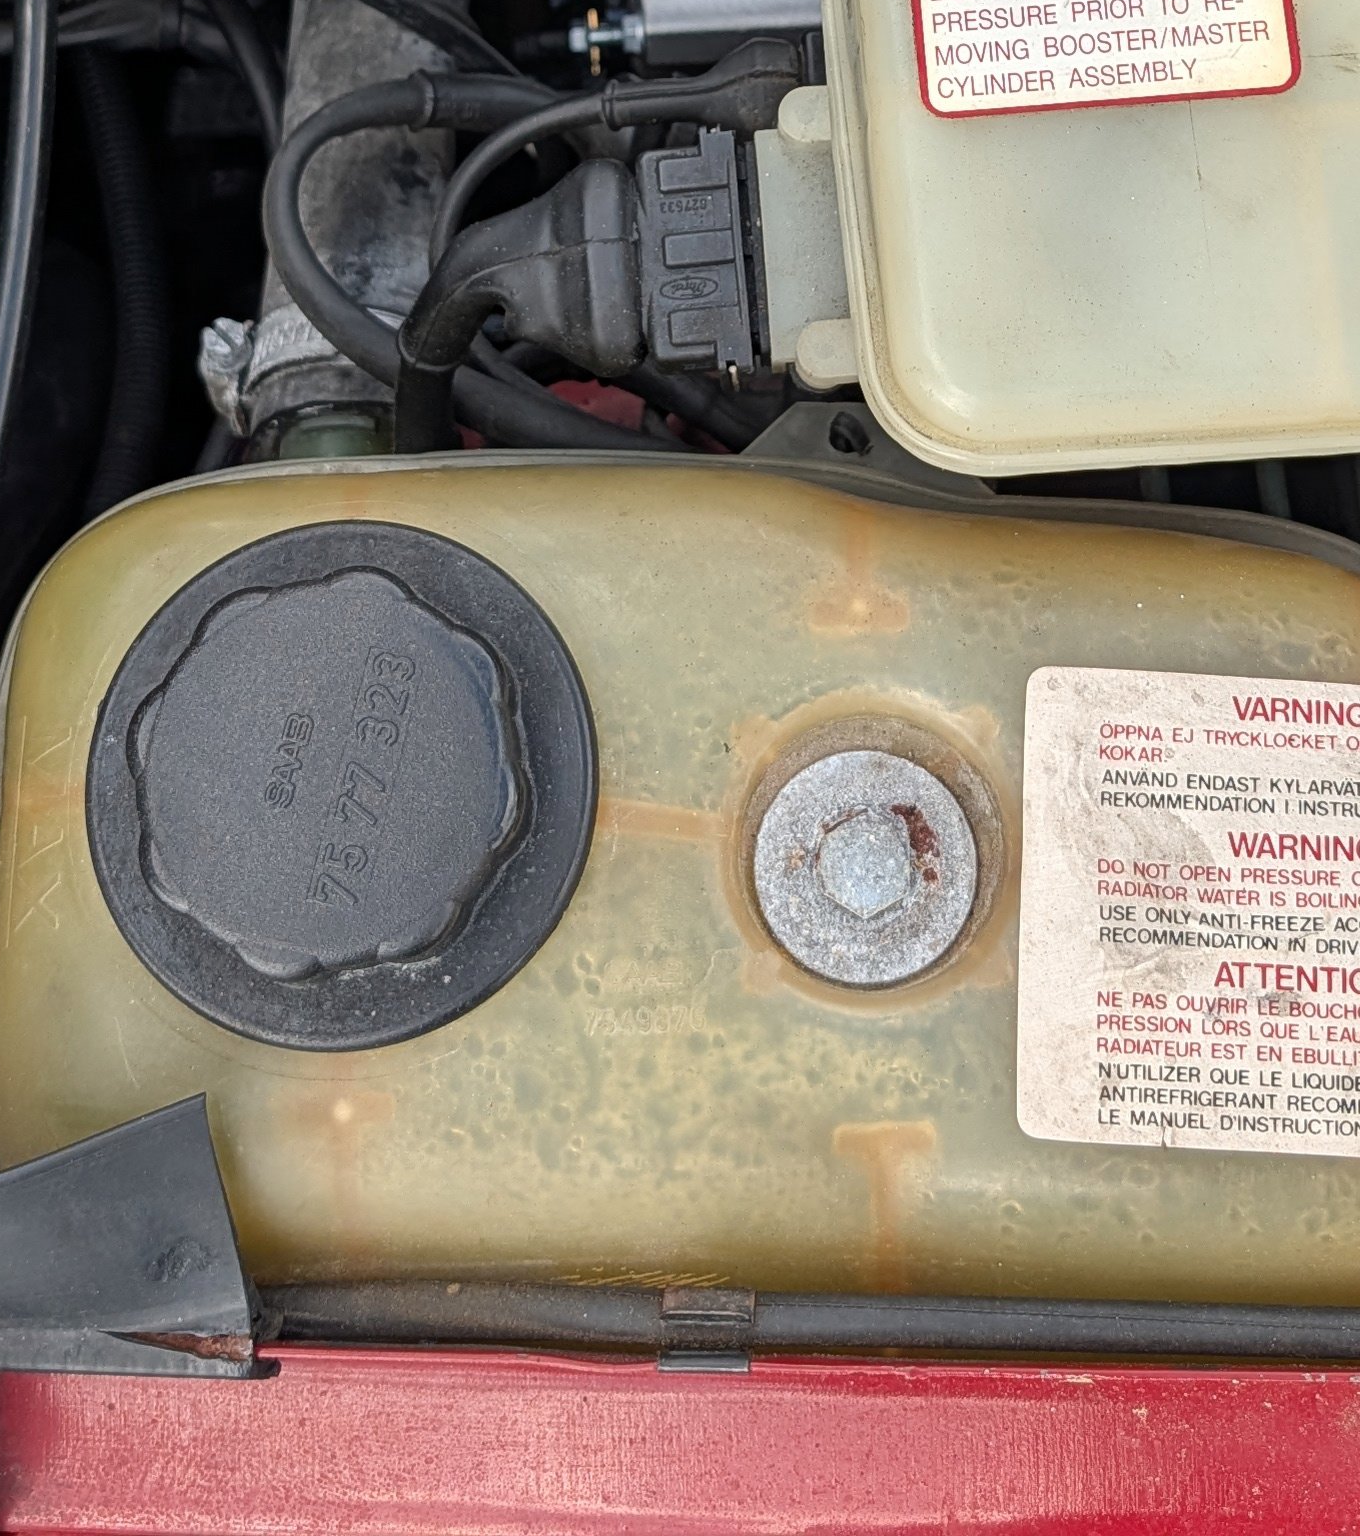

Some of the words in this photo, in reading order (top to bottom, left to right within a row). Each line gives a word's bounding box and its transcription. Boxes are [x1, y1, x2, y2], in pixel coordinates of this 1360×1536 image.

[933, 4, 1057, 33] PRESSURE
[935, 38, 1030, 65] MOVING
[937, 69, 1054, 99] CYLINDER
[1069, 58, 1197, 88] ASSEMBLY
[356, 650, 417, 747] 323
[1099, 723, 1164, 742] ÖPPNA
[1171, 727, 1195, 744] EJ
[1203, 728, 1339, 751] TRYCKLOCKET
[265, 712, 316, 811] SAAB
[334, 761, 387, 825] 77
[1101, 769, 1179, 790] ANVÄND
[1187, 774, 1261, 793] ENDAST
[1100, 792, 1278, 815] REKOMMENDATION
[1285, 798, 1291, 814] I
[307, 843, 369, 907] 75
[1098, 859, 1126, 876] DO
[1133, 861, 1172, 879] NOT
[1179, 863, 1231, 882] OPEN
[1240, 867, 1341, 887] PRESSURE
[1098, 881, 1188, 902] RADIATOR
[1195, 886, 1260, 906] WATER
[1269, 889, 1284, 907] IS
[1100, 905, 1137, 923] USE
[1145, 907, 1192, 926] ONLY
[1199, 911, 1325, 932] ANTI-FREEZE
[1100, 927, 1278, 951] RECOMMENDATION
[1288, 933, 1307, 951] IN
[1097, 991, 1123, 1008] NE
[1132, 993, 1168, 1010] PAS
[1176, 995, 1247, 1015] OUVRIR
[1258, 1000, 1281, 1016] LE
[1097, 1015, 1191, 1035] PRESSION
[1200, 1018, 1251, 1038] LORS
[1260, 1022, 1300, 1040] QUE
[1097, 1038, 1202, 1058] RADIATEUR
[1210, 1042, 1245, 1060] EST
[1257, 1045, 1283, 1061] EN
[1098, 1064, 1202, 1083] N'UTILIZER
[1209, 1067, 1251, 1085] QUE
[1259, 1070, 1283, 1087] LE
[1098, 1085, 1277, 1110] ANTIREFRIGERANT
[1098, 1109, 1123, 1125] LE
[1130, 1110, 1211, 1131] MANUEL
